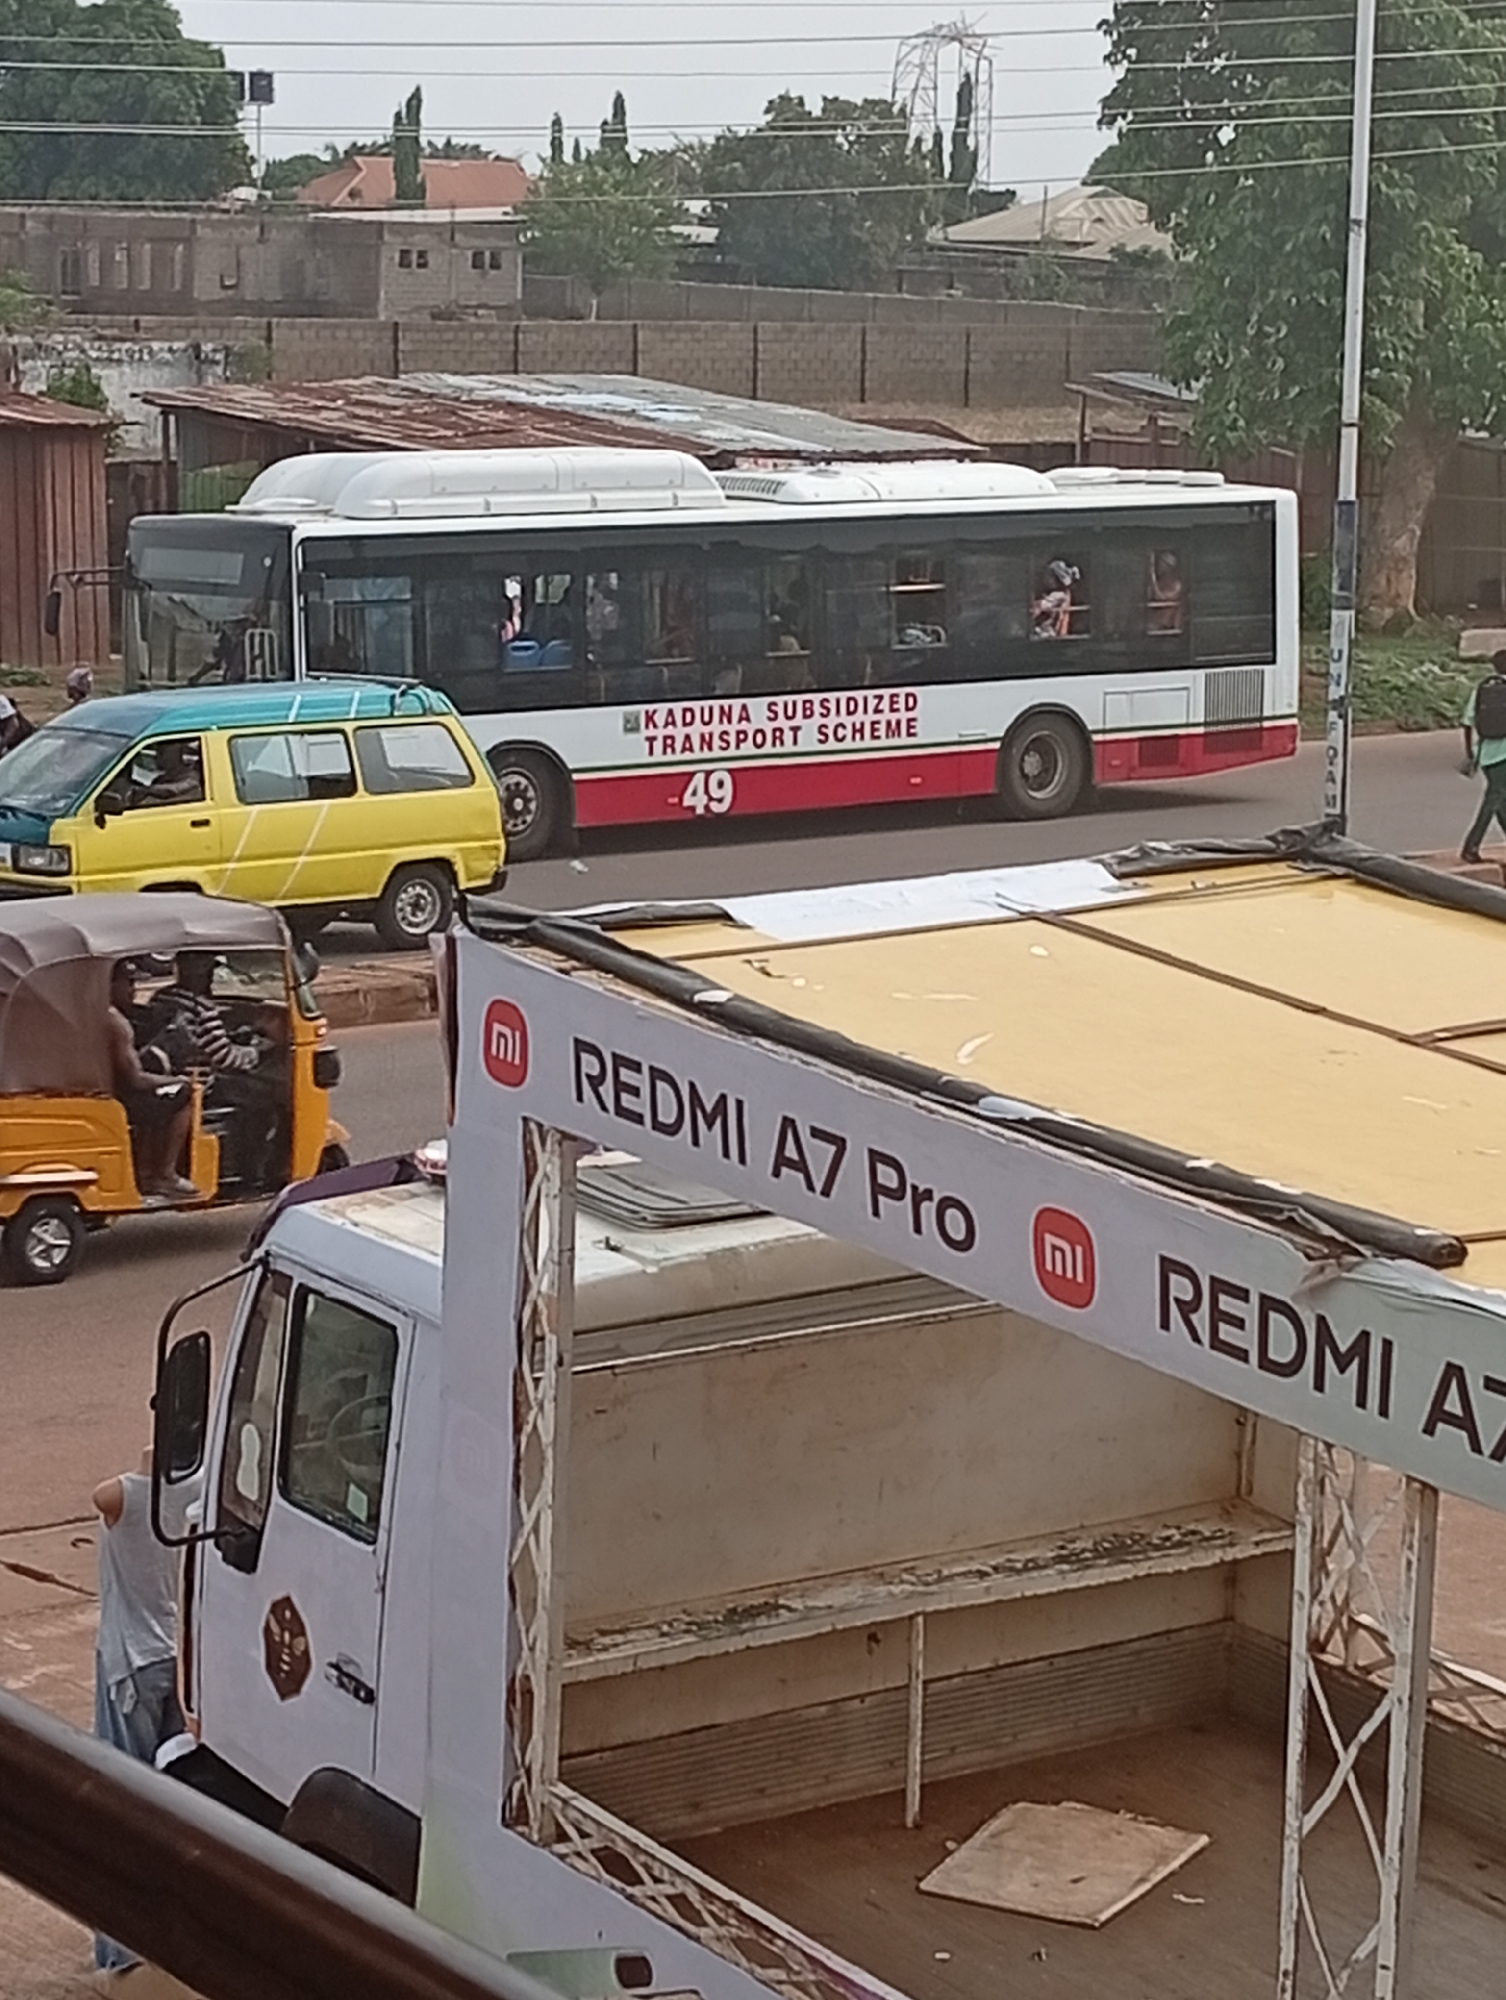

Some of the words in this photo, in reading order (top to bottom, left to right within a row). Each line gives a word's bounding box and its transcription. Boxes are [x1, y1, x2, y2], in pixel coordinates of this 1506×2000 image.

[644, 704, 752, 730] KADUNA
[766, 692, 918, 722] SUBSIDIZED
[645, 726, 802, 757] TRANSPORT
[817, 717, 918, 745] SCHEME
[682, 770, 733, 814] 49
[573, 1036, 747, 1166] REDMI
[771, 1115, 847, 1198] A7
[867, 1147, 976, 1252] Pro
[1159, 1254, 1394, 1420] REDMI
